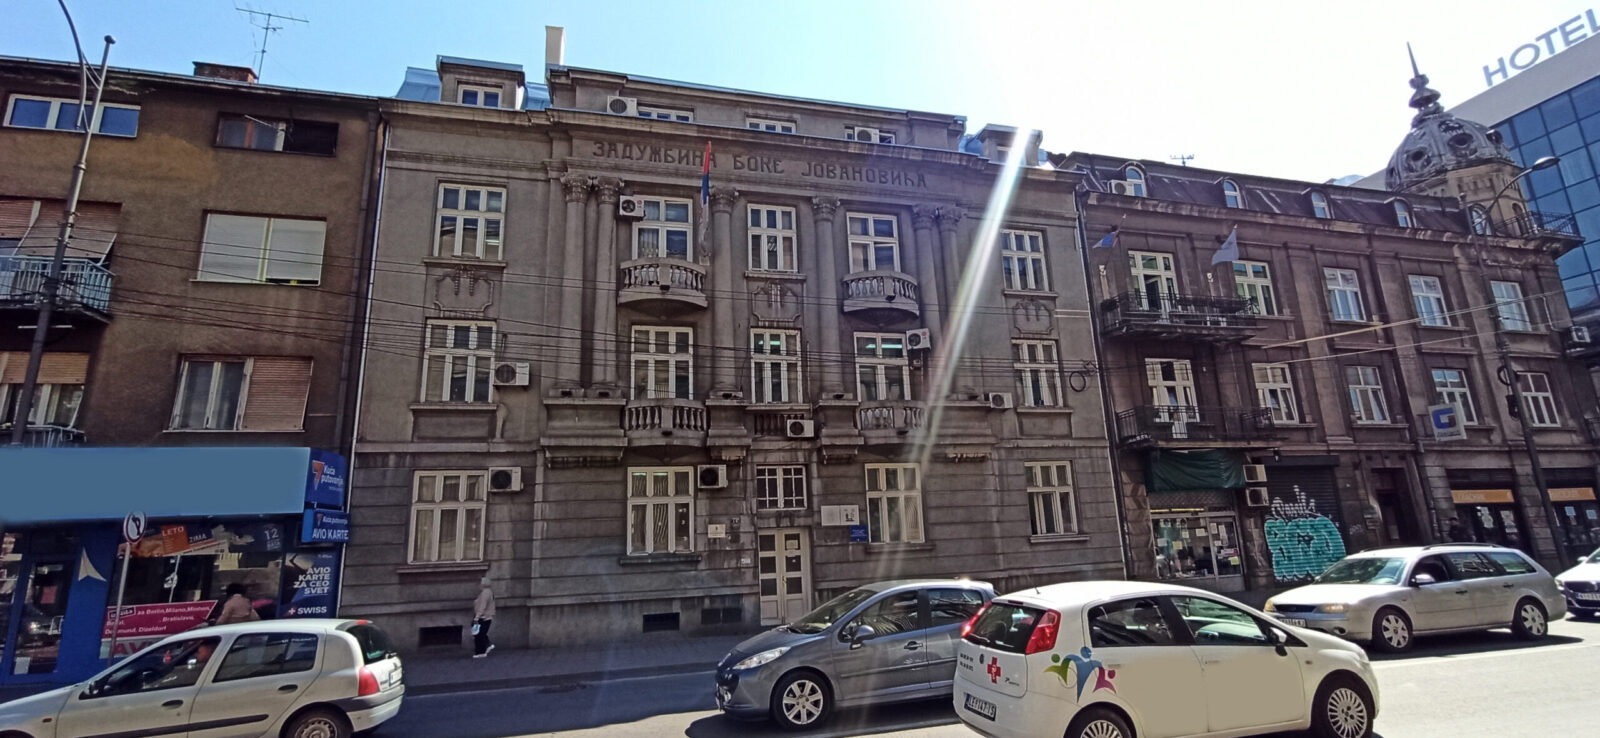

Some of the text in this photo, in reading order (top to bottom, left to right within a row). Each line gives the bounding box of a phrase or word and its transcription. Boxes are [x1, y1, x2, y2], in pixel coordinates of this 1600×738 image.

[1483, 8, 1600, 87] HOTEL
[593, 141, 717, 168] ЗАДУЖБИНА
[162, 527, 184, 537] LETO
[264, 528, 279, 540] 12
[312, 528, 349, 540] AVIO KARTE
[189, 534, 207, 543] ZIMA
[306, 567, 331, 575] AVIO
[298, 573, 331, 581] KARTE
[309, 580, 330, 588] CEO
[304, 586, 329, 595] SVET
[297, 606, 327, 615] SWISS
